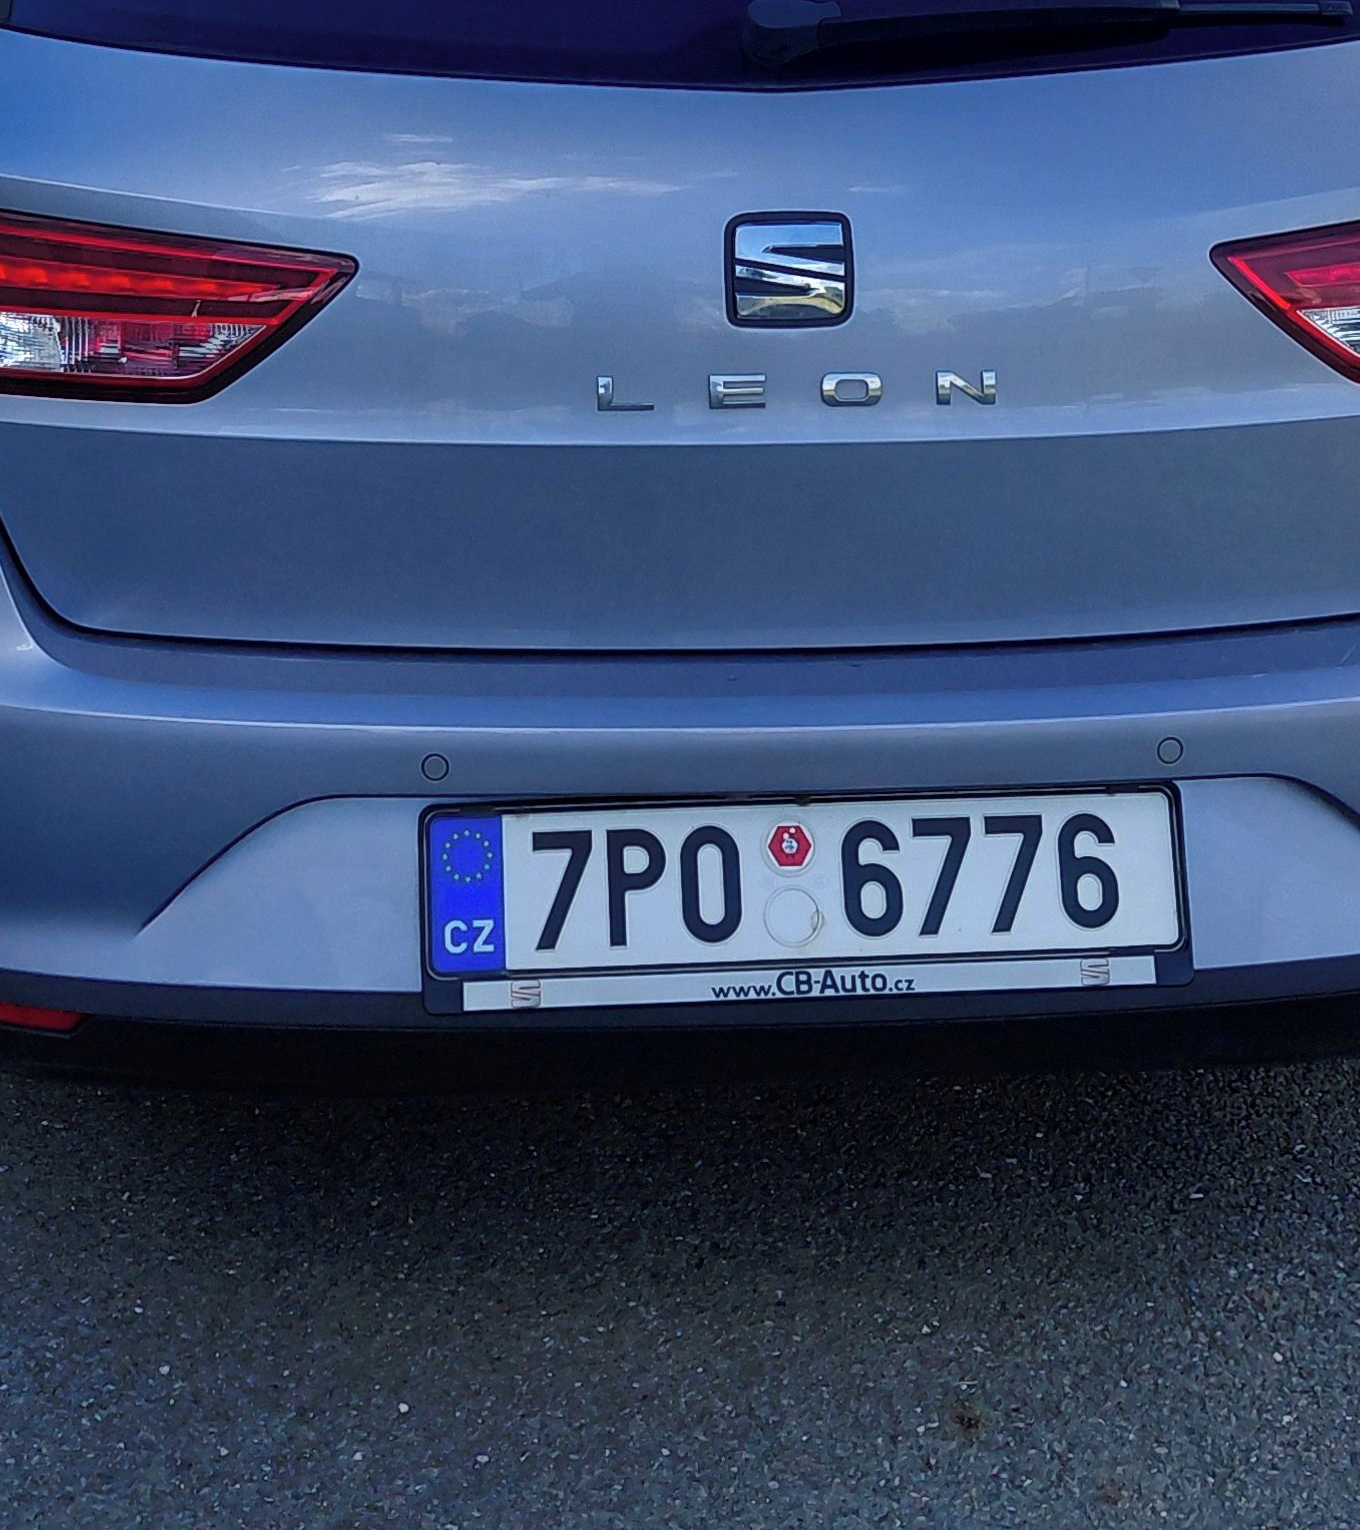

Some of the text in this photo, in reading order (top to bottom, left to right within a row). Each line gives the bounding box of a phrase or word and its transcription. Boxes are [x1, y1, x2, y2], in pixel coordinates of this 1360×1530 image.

[596, 369, 998, 412] LEON
[841, 813, 1120, 939] 6776
[444, 920, 495, 954] CZ
[711, 969, 916, 999] www.CB-Auto.cz
